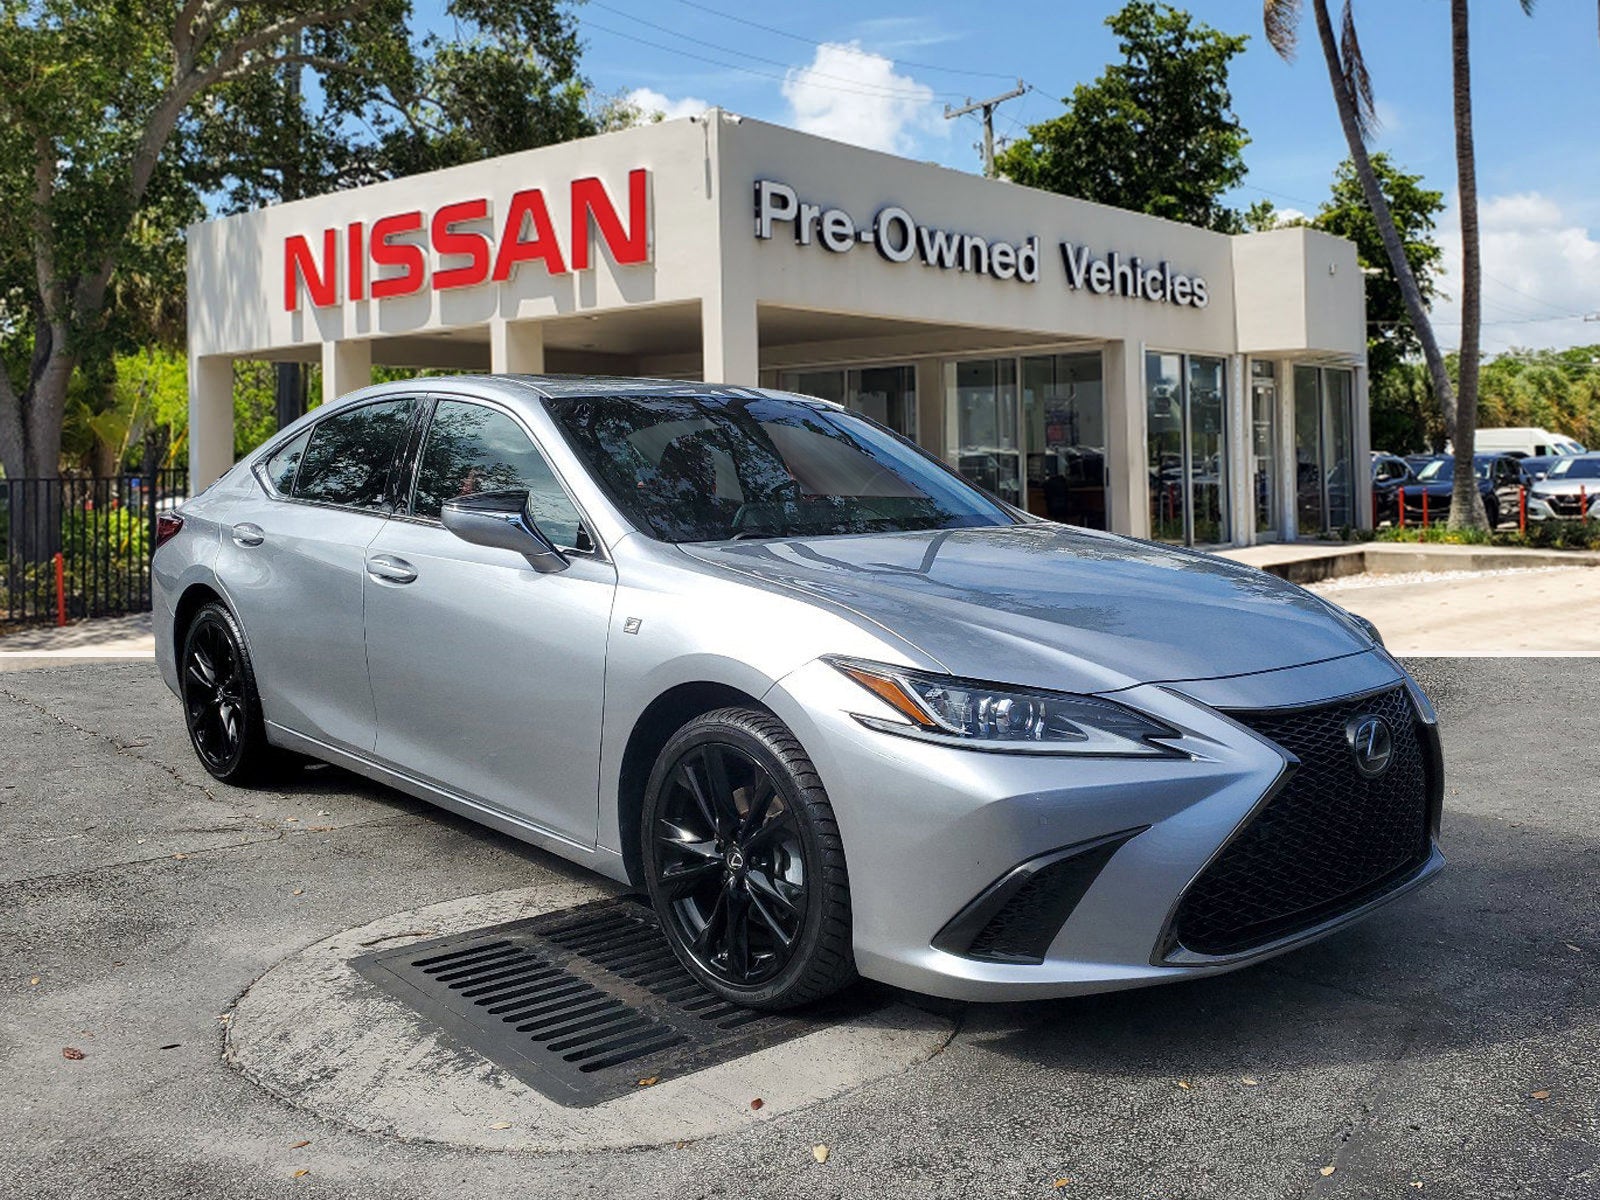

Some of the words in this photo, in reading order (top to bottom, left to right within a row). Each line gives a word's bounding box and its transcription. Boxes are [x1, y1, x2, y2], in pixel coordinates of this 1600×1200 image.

[285, 168, 648, 312] NISSAN
[754, 180, 1040, 284] Pre-Owned
[1060, 242, 1208, 308] Vehicles
